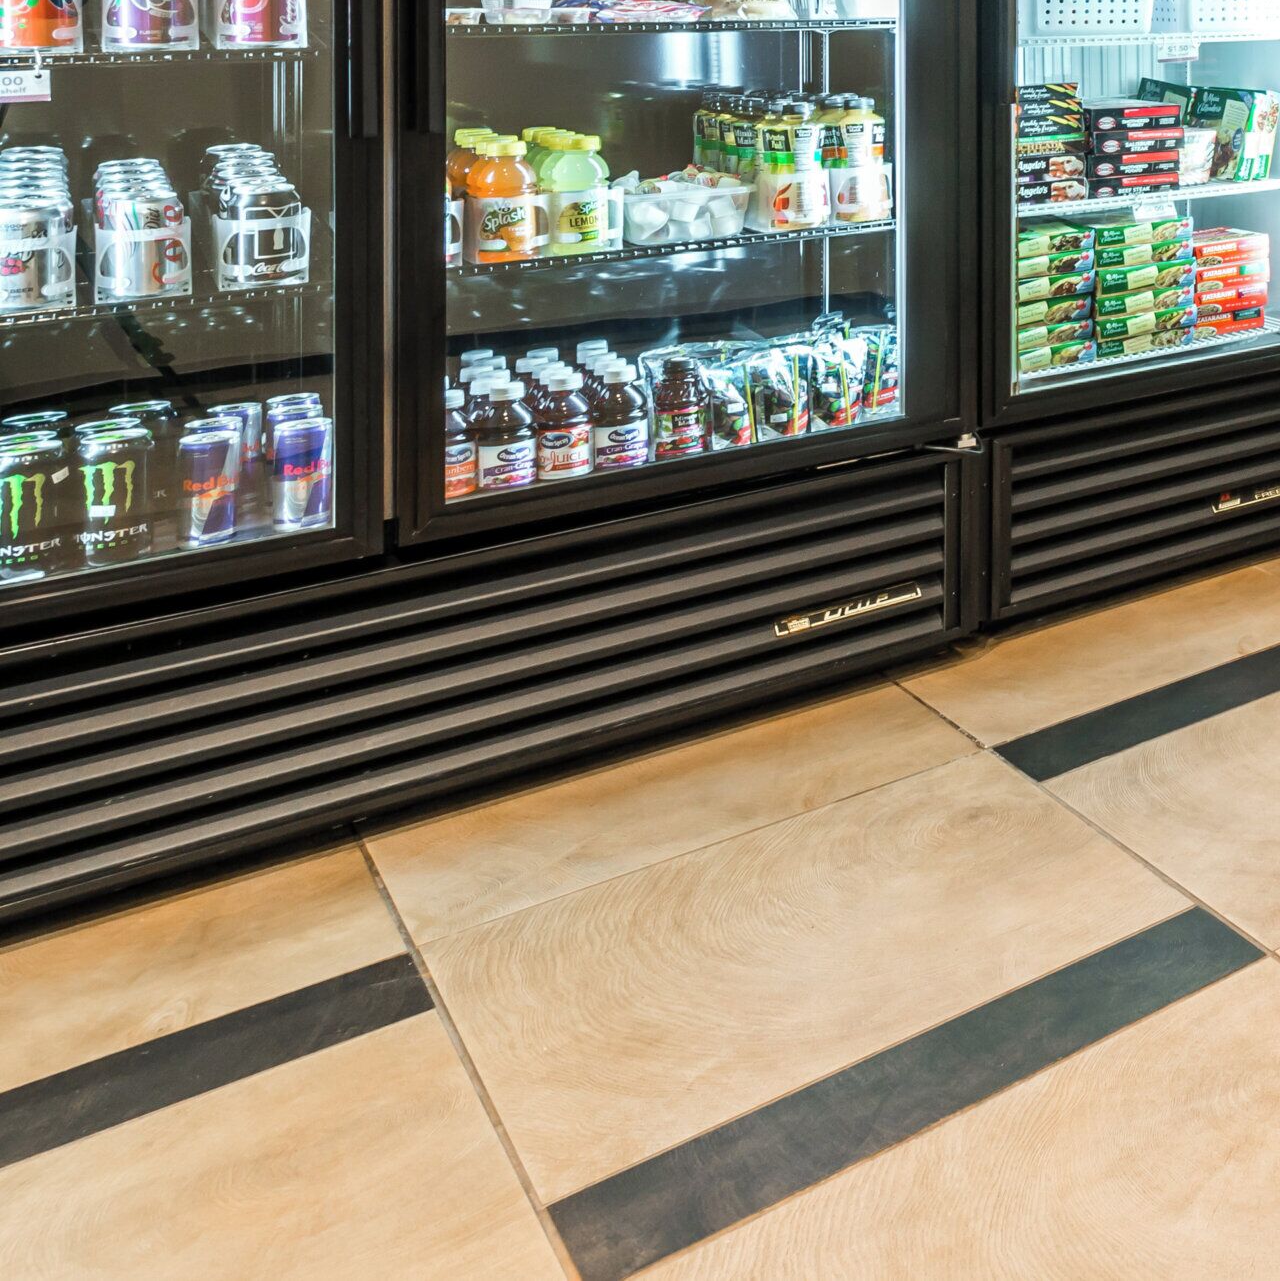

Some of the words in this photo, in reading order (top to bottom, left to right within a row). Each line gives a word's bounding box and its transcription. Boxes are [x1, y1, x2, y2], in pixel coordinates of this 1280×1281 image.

[484, 206, 526, 233] Splash
[283, 464, 310, 476] Red
[313, 459, 332, 473] Bu
[183, 478, 215, 491] Red
[217, 475, 240, 489] Bu
